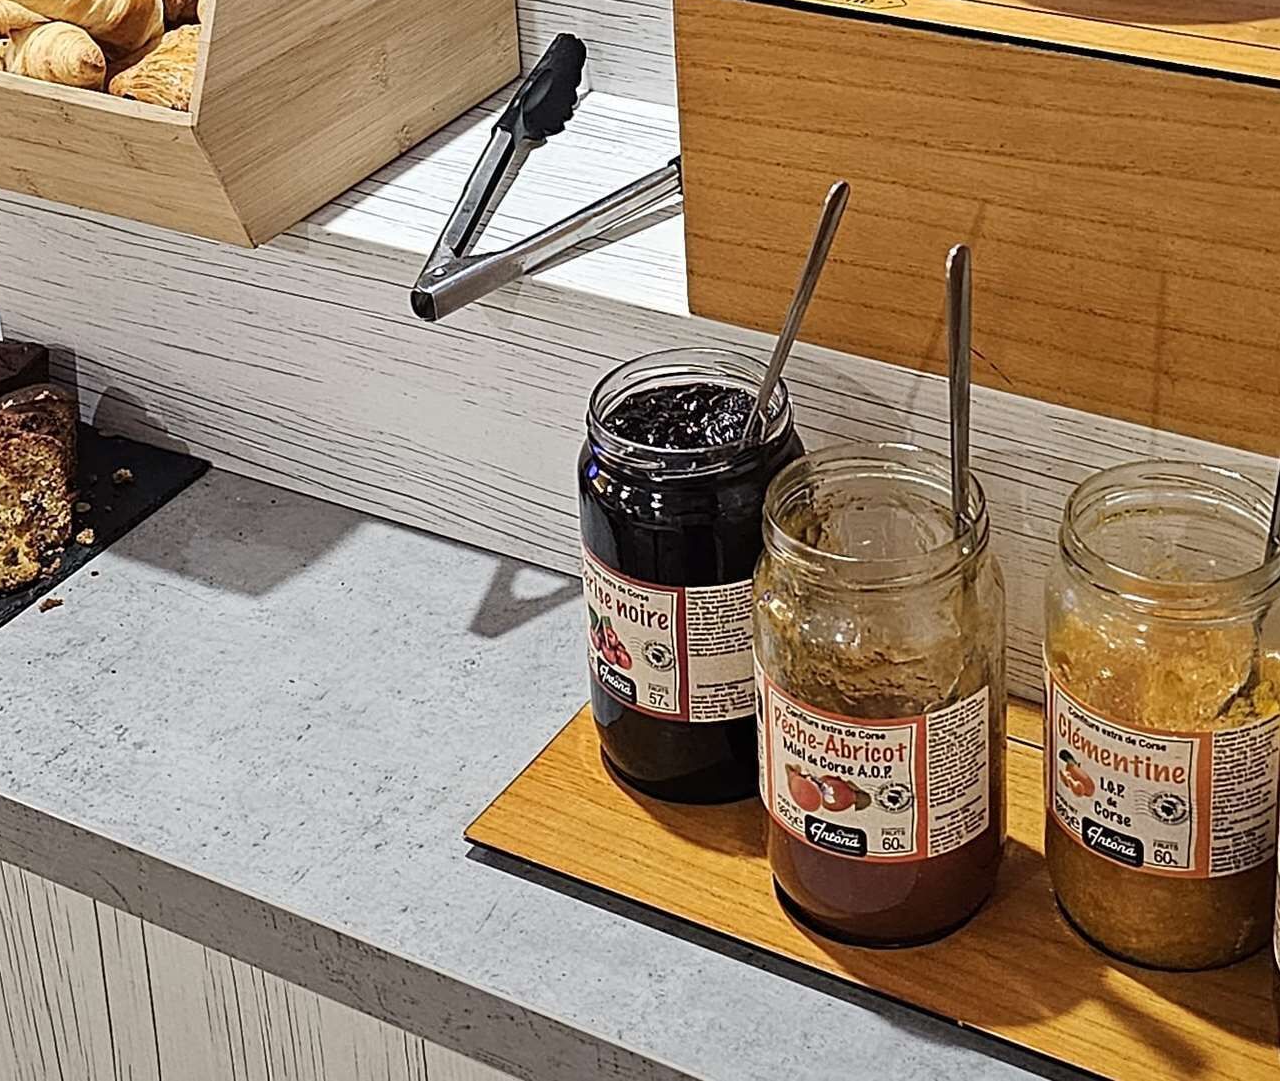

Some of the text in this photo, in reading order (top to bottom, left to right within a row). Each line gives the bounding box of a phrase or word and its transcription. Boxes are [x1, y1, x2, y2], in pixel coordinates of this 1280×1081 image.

[616, 598, 669, 631] noire
[844, 728, 857, 738] de
[858, 730, 886, 740] Corse
[1058, 711, 1186, 784] Clémentine
[1125, 735, 1137, 746] de
[1138, 738, 1167, 752] Corse
[782, 736, 893, 779] Miel de Corse A.O.P.
[1094, 800, 1132, 827] Corse
[1106, 796, 1118, 808] de
[809, 822, 861, 847] Antona
[1086, 826, 1137, 857] Antona
